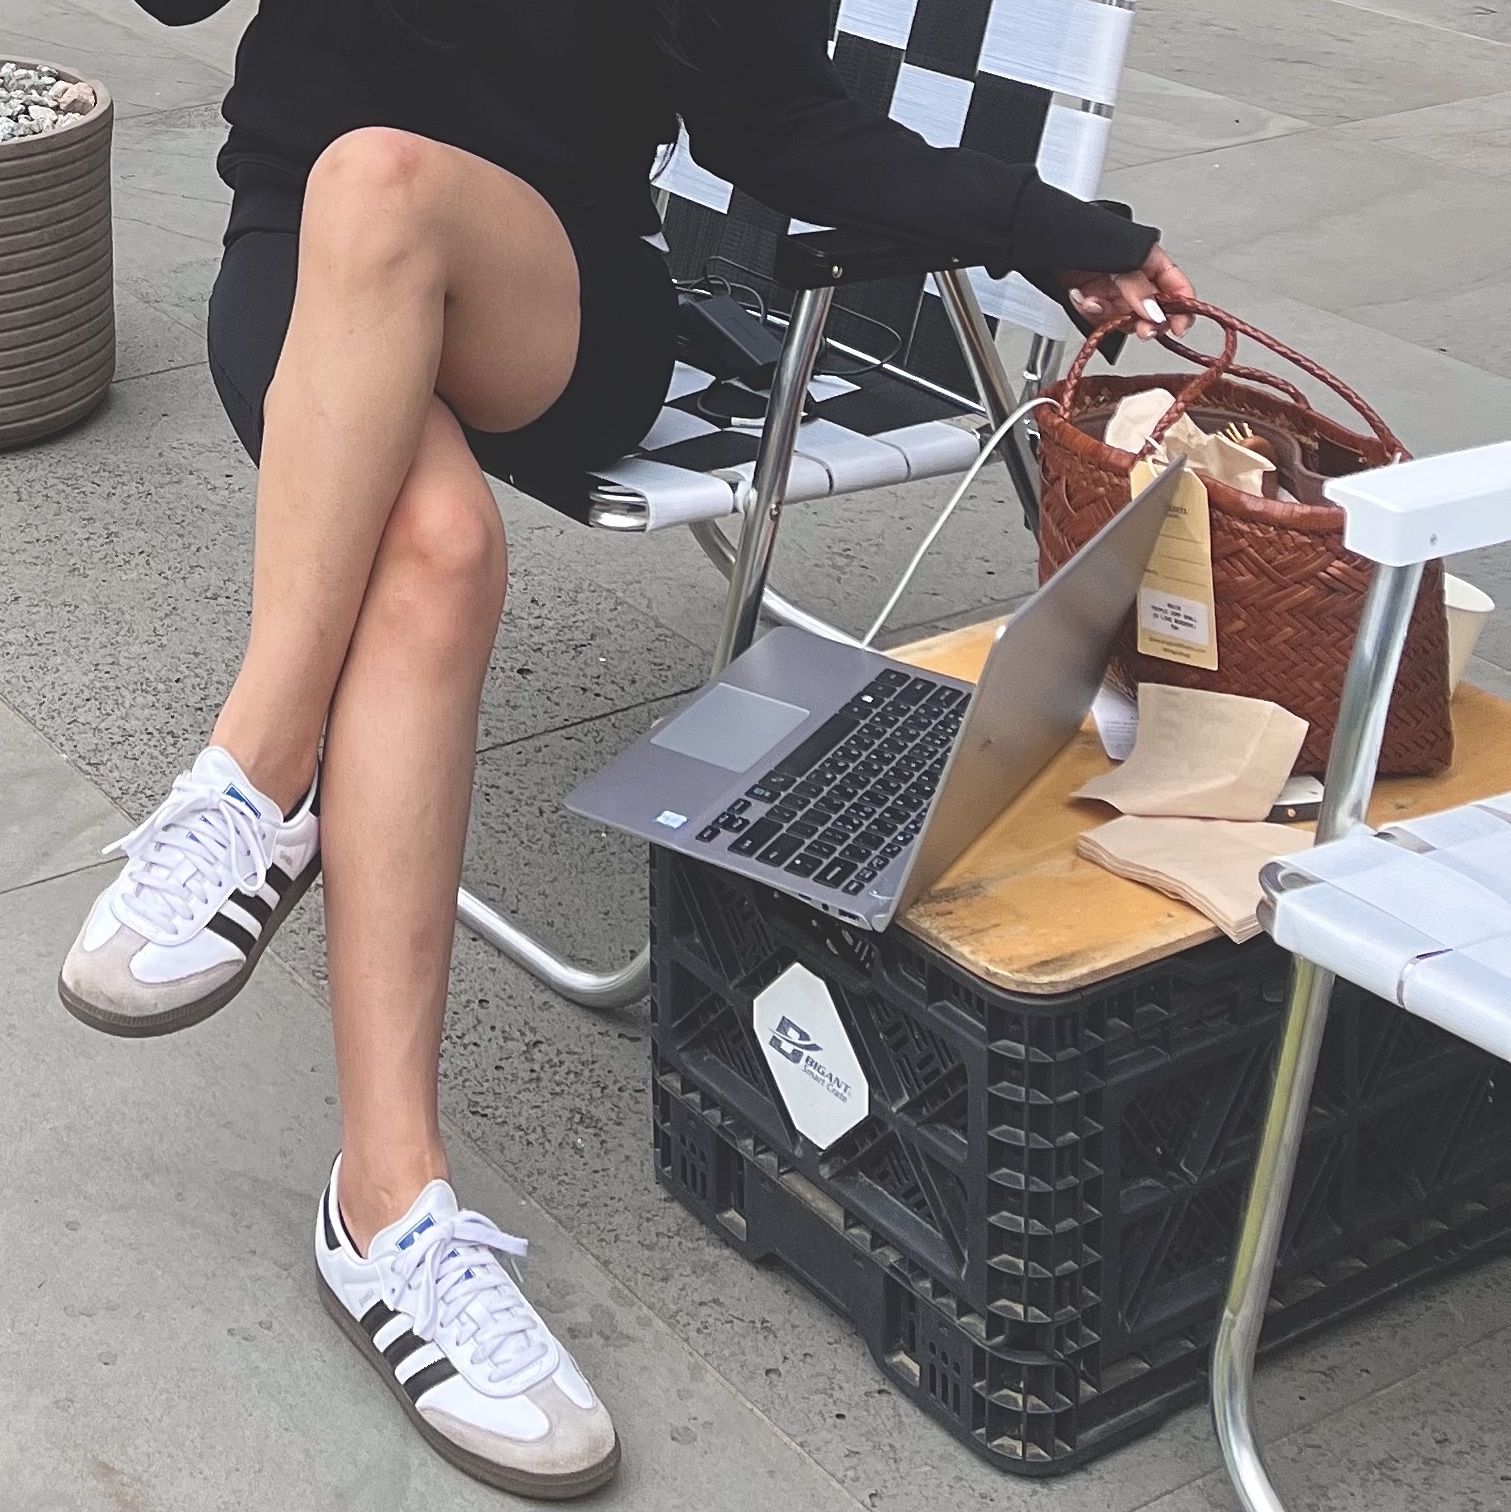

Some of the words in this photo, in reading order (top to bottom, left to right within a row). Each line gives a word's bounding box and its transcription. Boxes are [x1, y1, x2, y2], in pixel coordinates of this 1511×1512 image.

[801, 1064, 826, 1087] Smart
[826, 1082, 848, 1103] Crate
[805, 1055, 851, 1093] BIGANT
